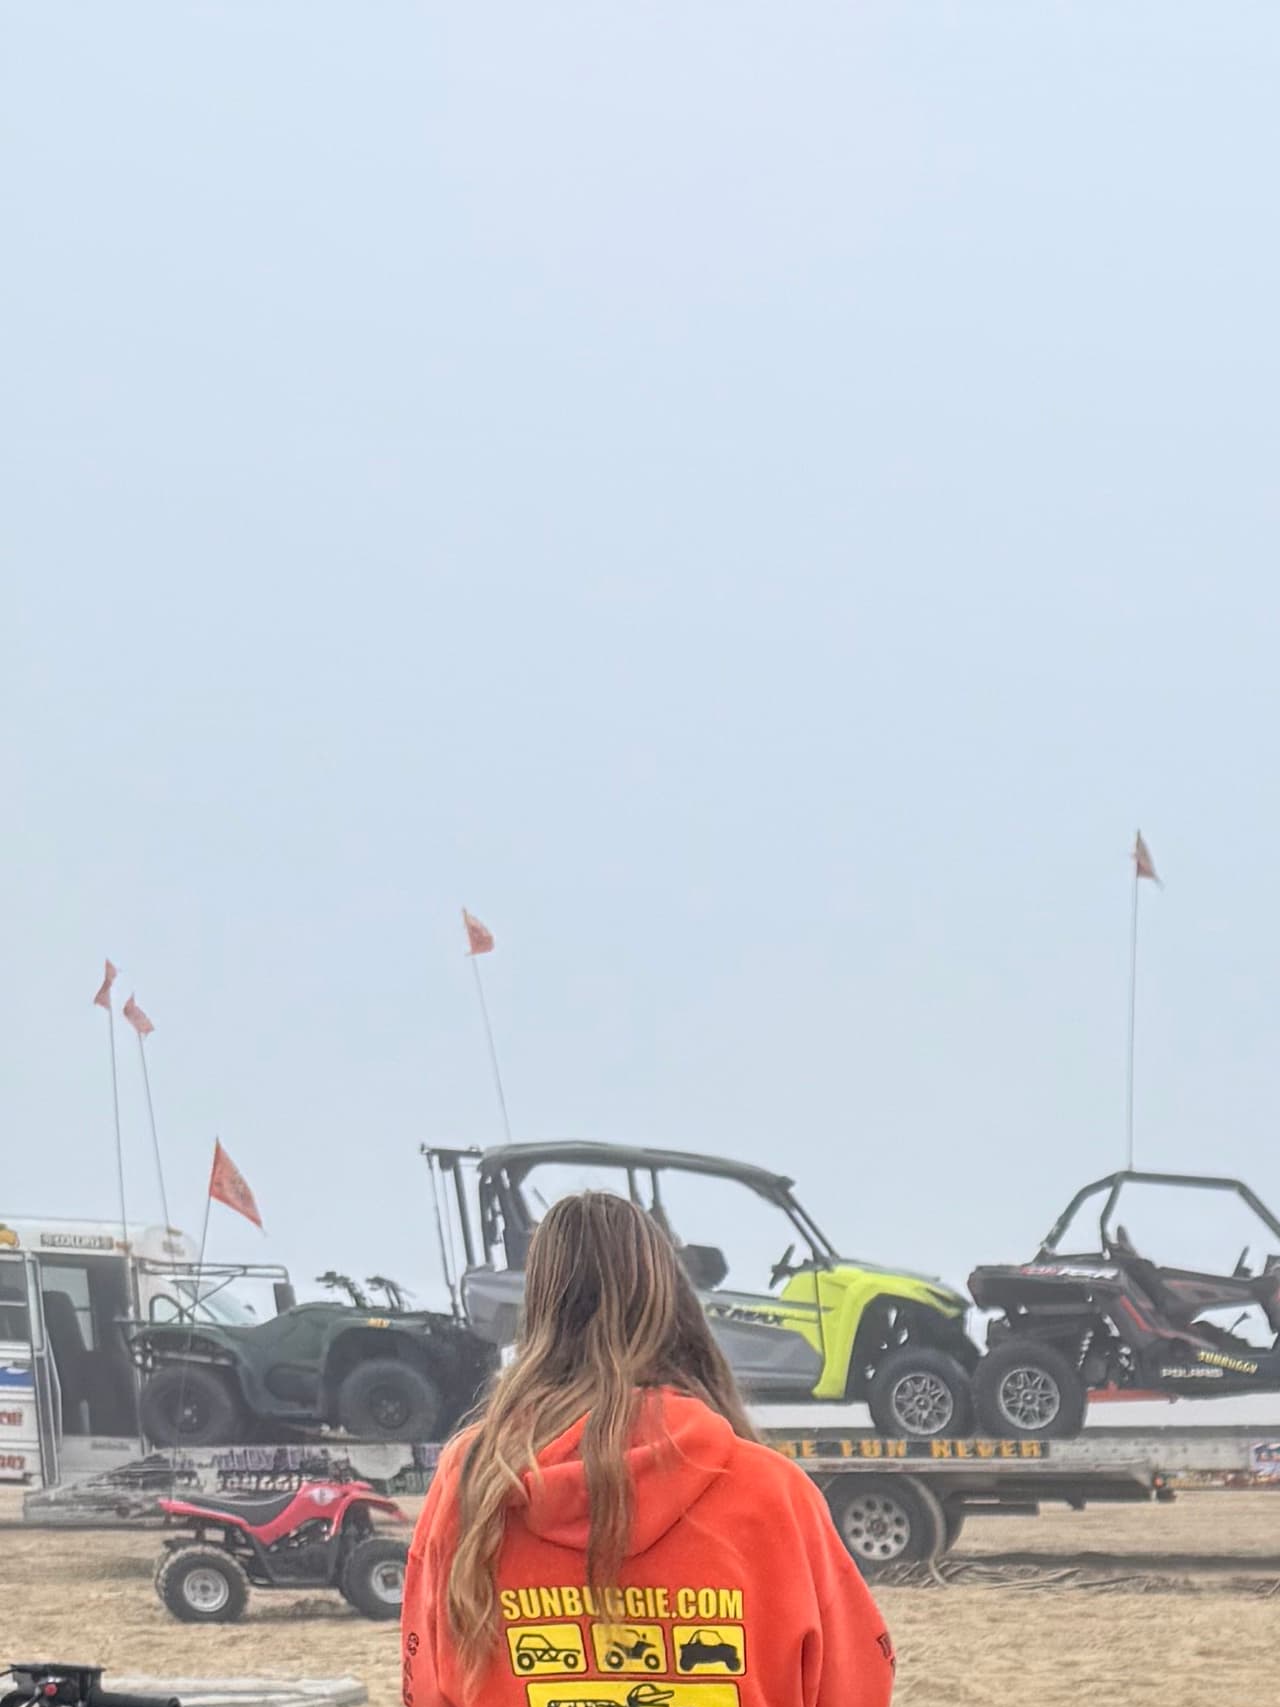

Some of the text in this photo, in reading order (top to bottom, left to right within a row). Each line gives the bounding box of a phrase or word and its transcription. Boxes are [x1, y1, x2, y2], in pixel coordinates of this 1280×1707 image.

[1162, 1367, 1223, 1378] POLARIS
[841, 1440, 908, 1459] FUN
[931, 1439, 1043, 1459] NEVER
[499, 1586, 744, 1621] SUNBUGGIE.COM
